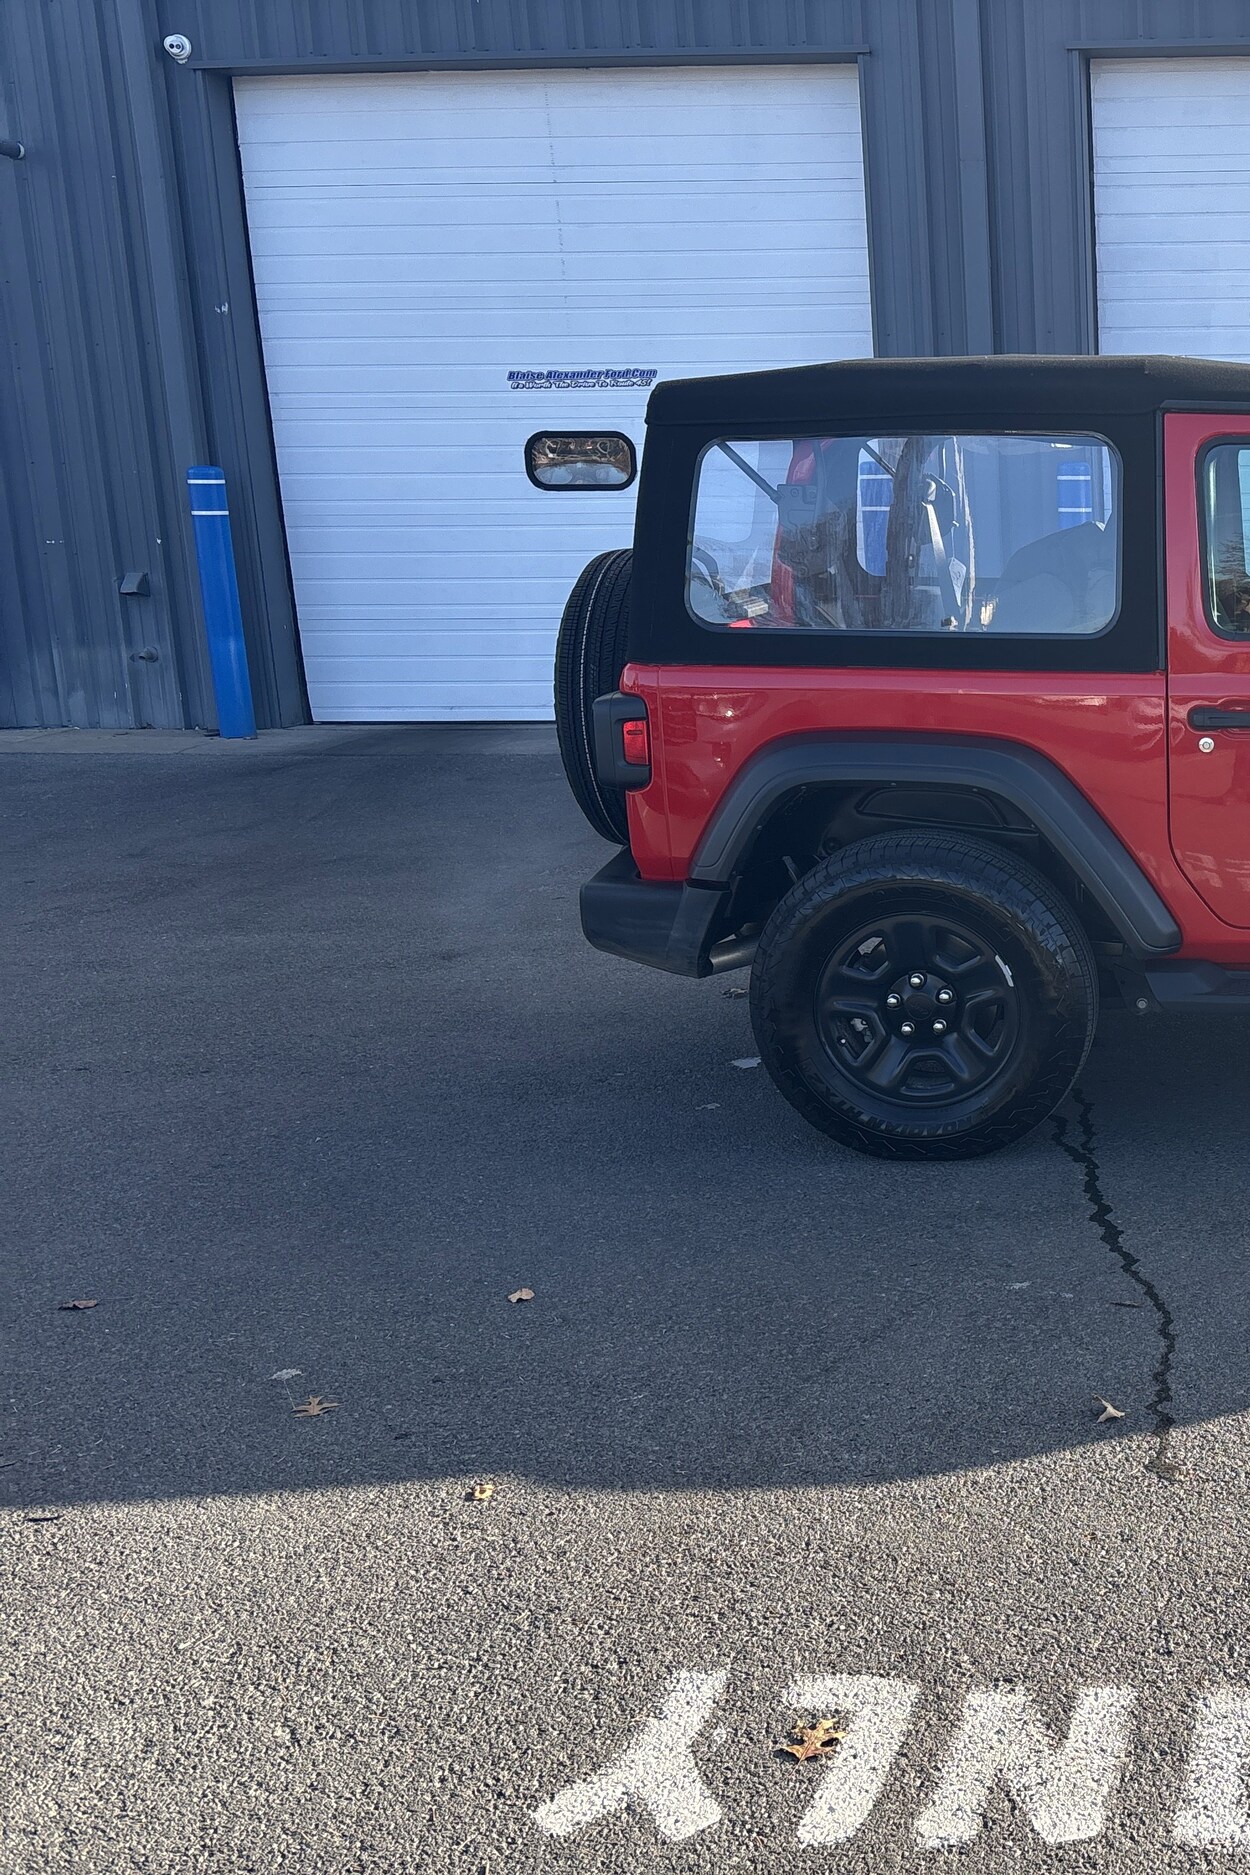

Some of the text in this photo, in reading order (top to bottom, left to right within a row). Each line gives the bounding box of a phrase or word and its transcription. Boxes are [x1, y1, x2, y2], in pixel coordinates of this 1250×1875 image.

[507, 370, 545, 381] Blaise
[546, 369, 604, 381] Alexander
[525, 380, 552, 389] Worth
[552, 381, 570, 389] The
[570, 380, 596, 389] Drive
[596, 380, 608, 388] To
[609, 379, 634, 388] Route
[634, 378, 652, 387] 45!
